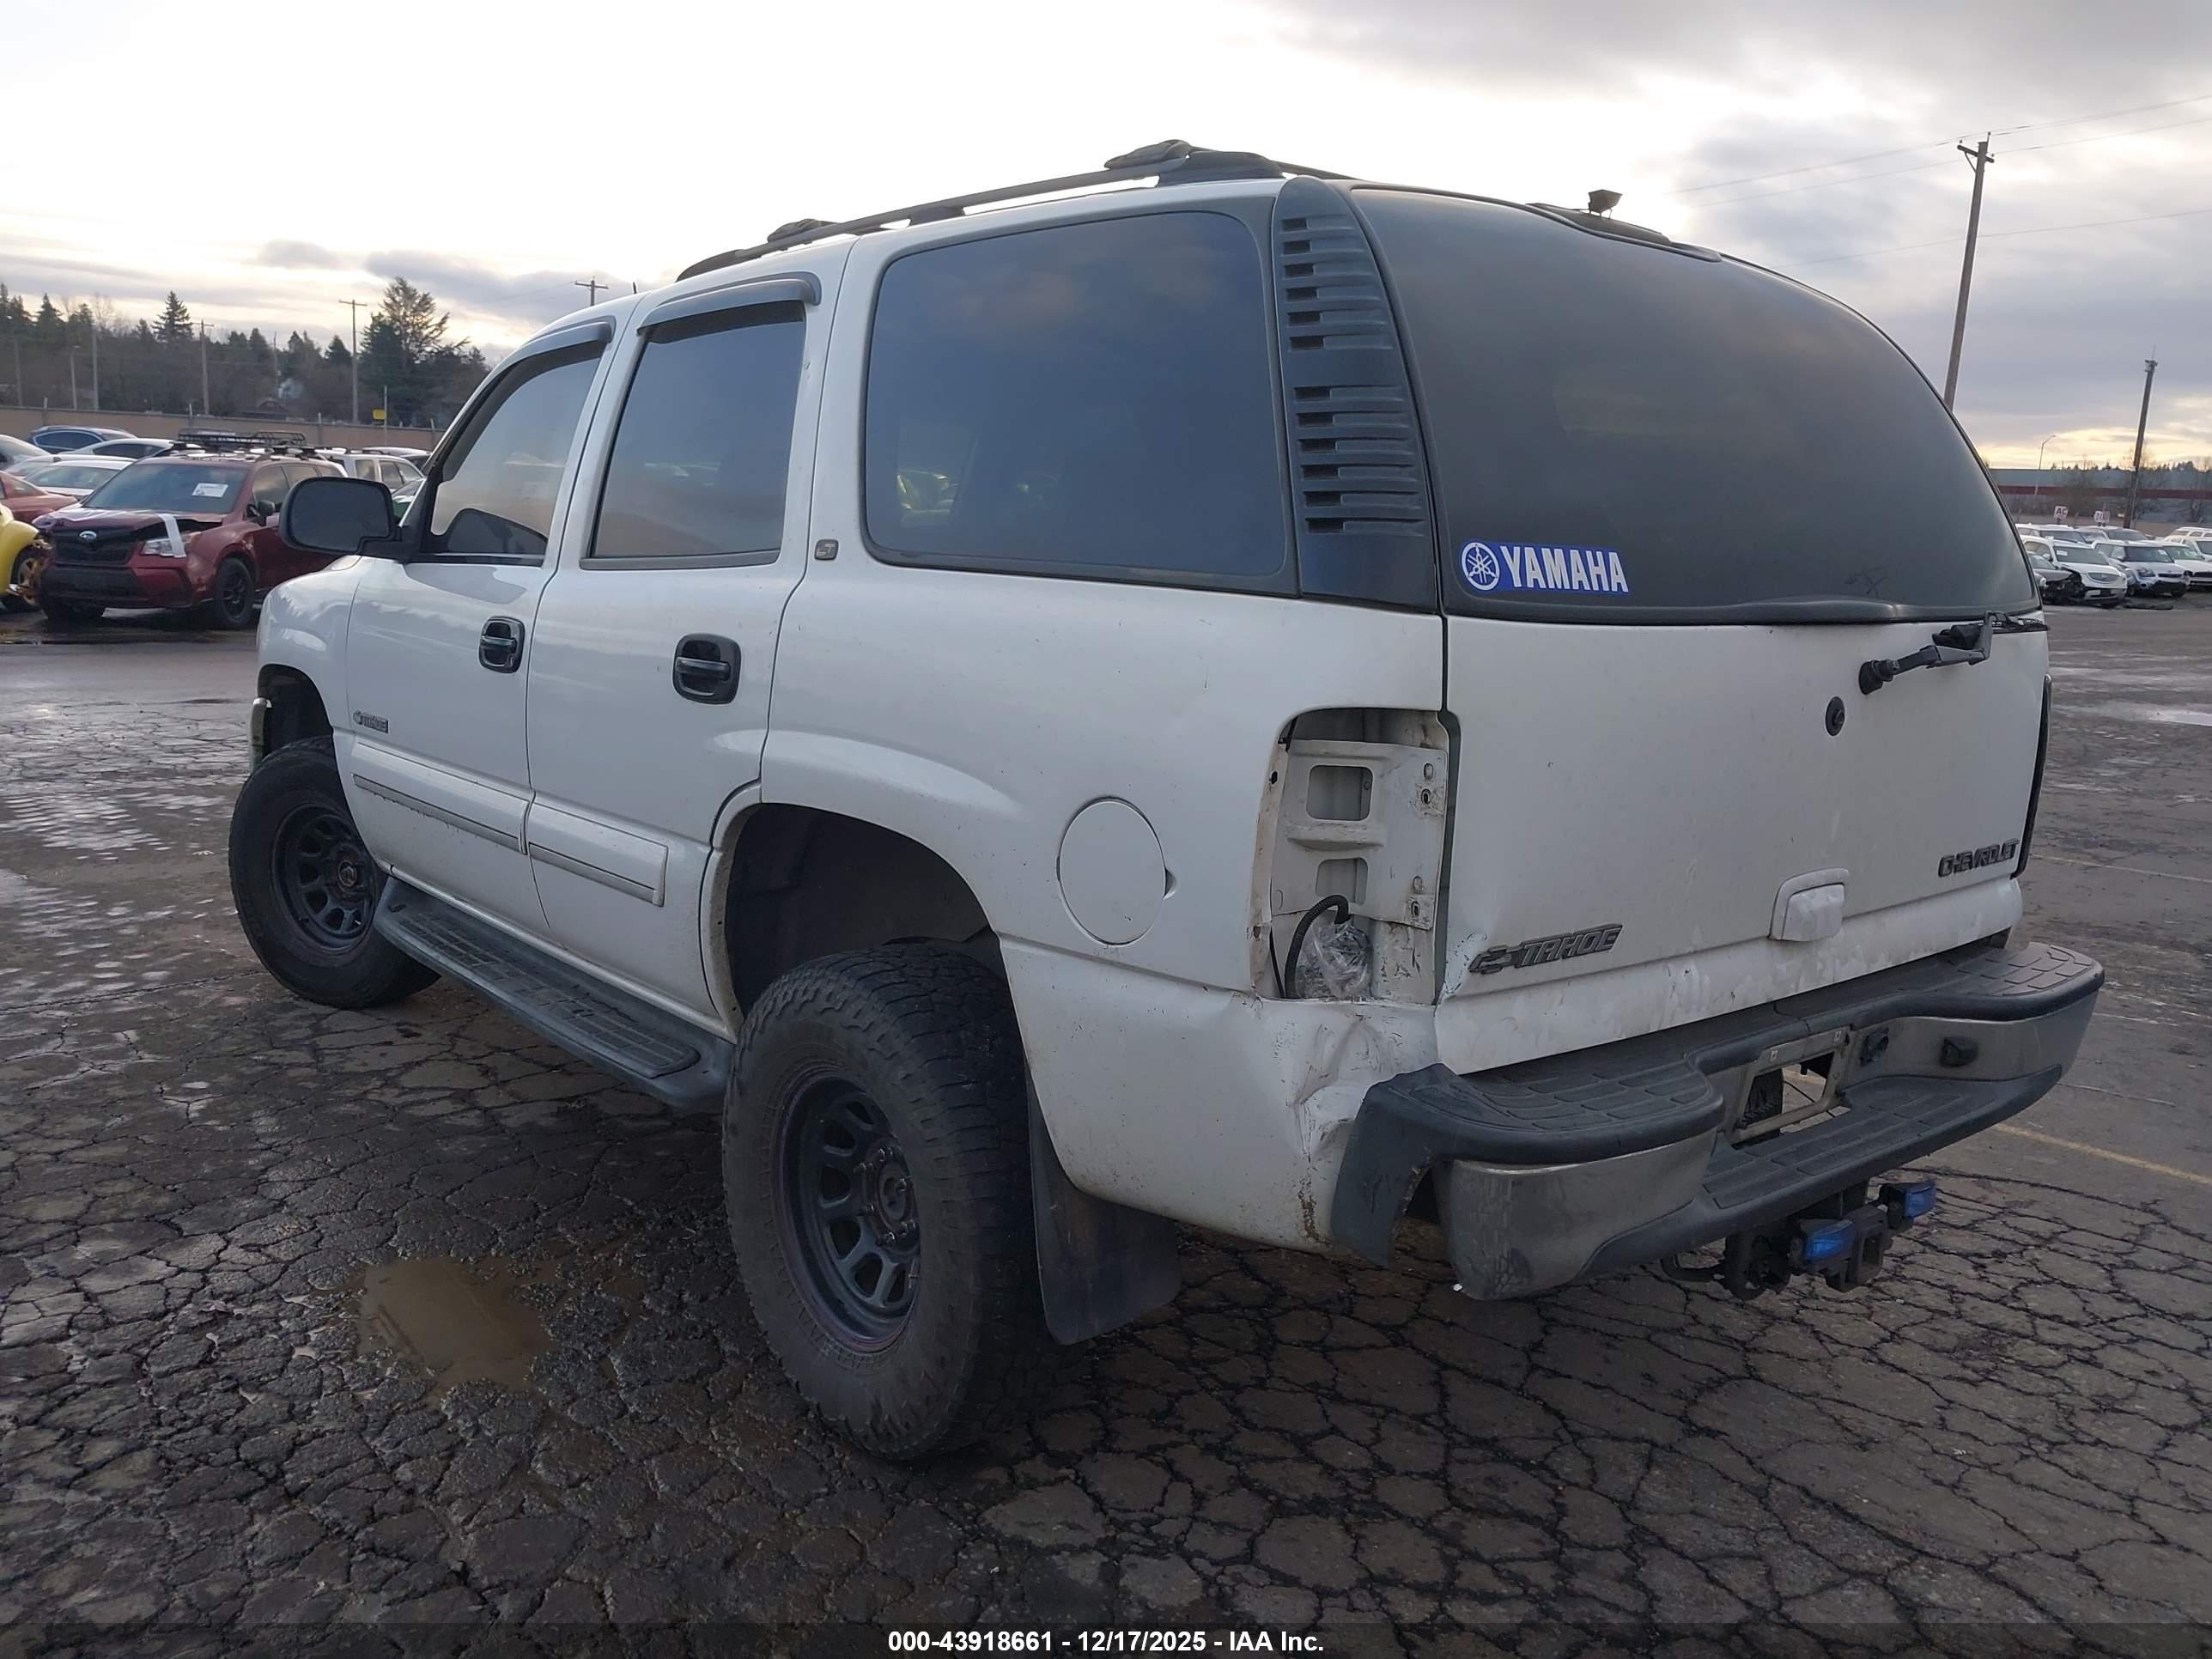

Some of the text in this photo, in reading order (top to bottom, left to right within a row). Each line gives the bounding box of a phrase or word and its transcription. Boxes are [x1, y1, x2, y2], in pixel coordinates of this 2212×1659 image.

[1500, 545, 1629, 592] YAMAHA
[1938, 838, 2020, 878] CHEVROLET
[1518, 925, 1624, 968] TAHOE
